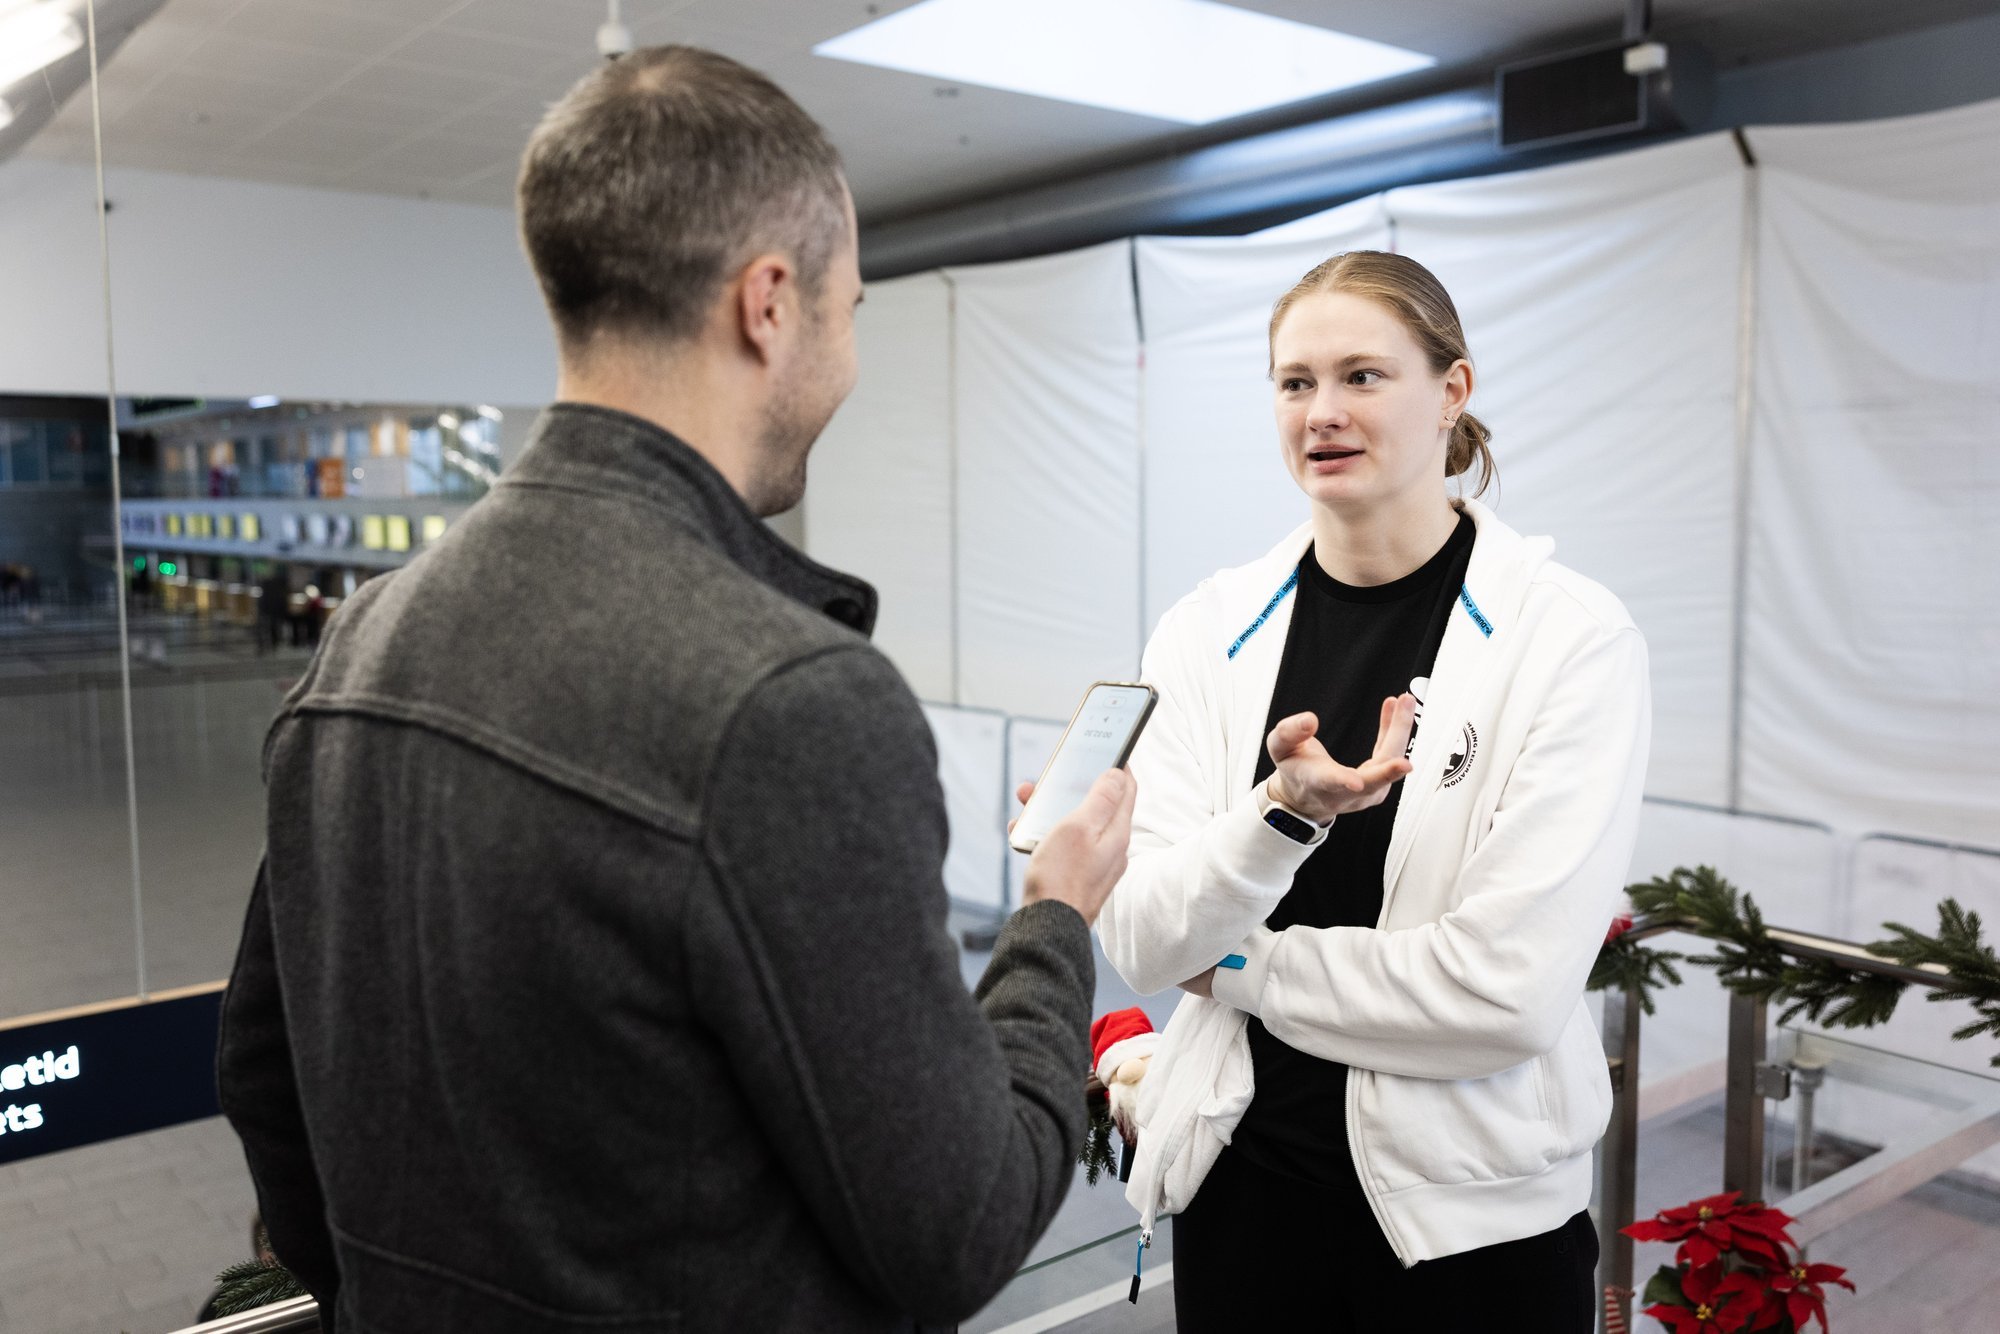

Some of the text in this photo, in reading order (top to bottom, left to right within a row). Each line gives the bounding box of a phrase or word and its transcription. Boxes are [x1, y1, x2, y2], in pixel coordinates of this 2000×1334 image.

[1261, 601, 1275, 618] arena
[1472, 612, 1487, 628] arena
[1239, 627, 1255, 643] arena
[1444, 750, 1477, 788] FEDERATION
[0, 1045, 80, 1093] etid
